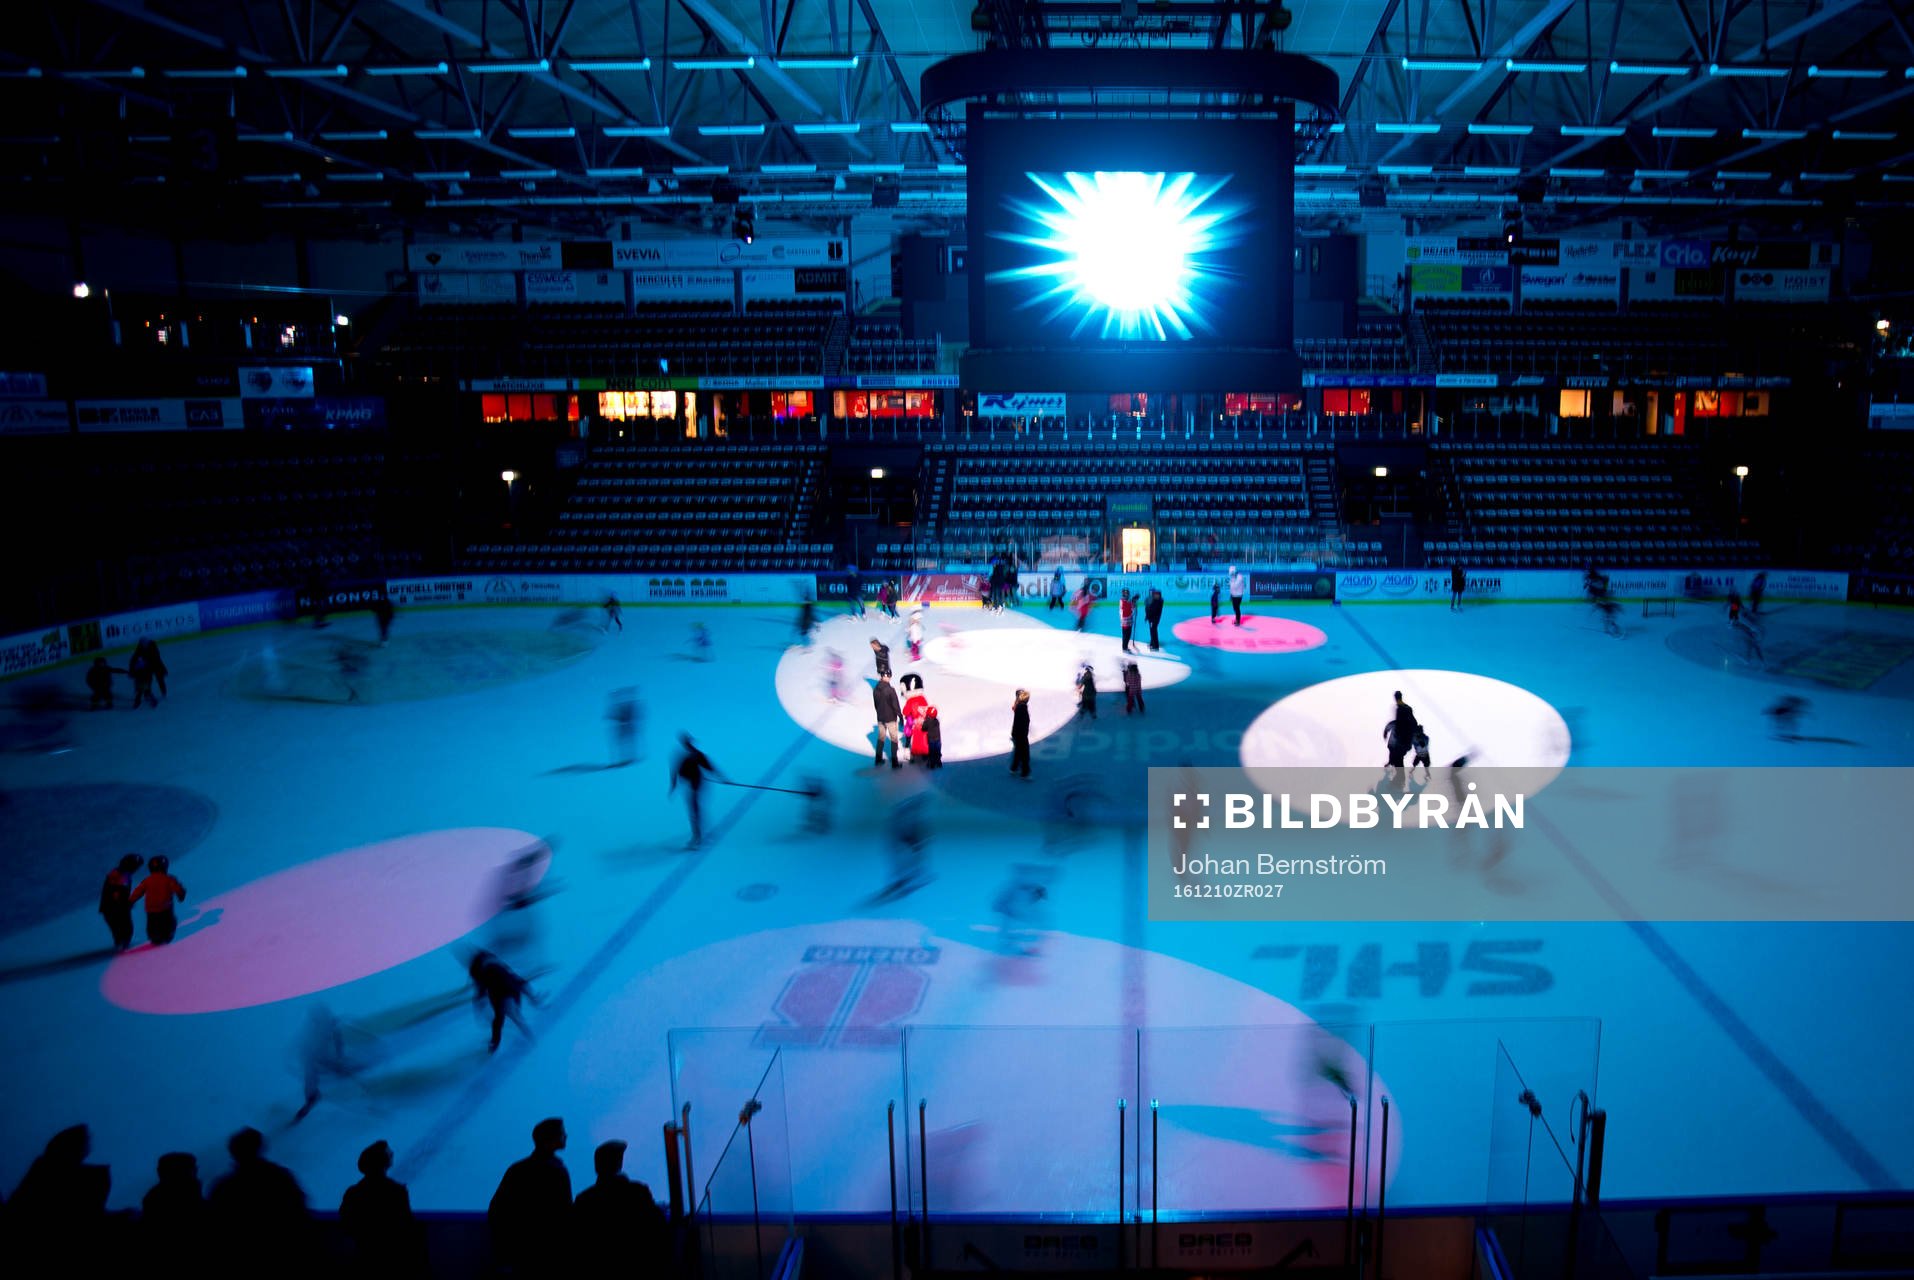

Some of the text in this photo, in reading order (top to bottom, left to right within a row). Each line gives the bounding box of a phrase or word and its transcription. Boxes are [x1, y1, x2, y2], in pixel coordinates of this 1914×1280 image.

[616, 248, 661, 262] SVEVIA
[797, 271, 839, 285] ADMIT
[325, 408, 373, 421] KPMG
[1250, 939, 1556, 1000] SHL
